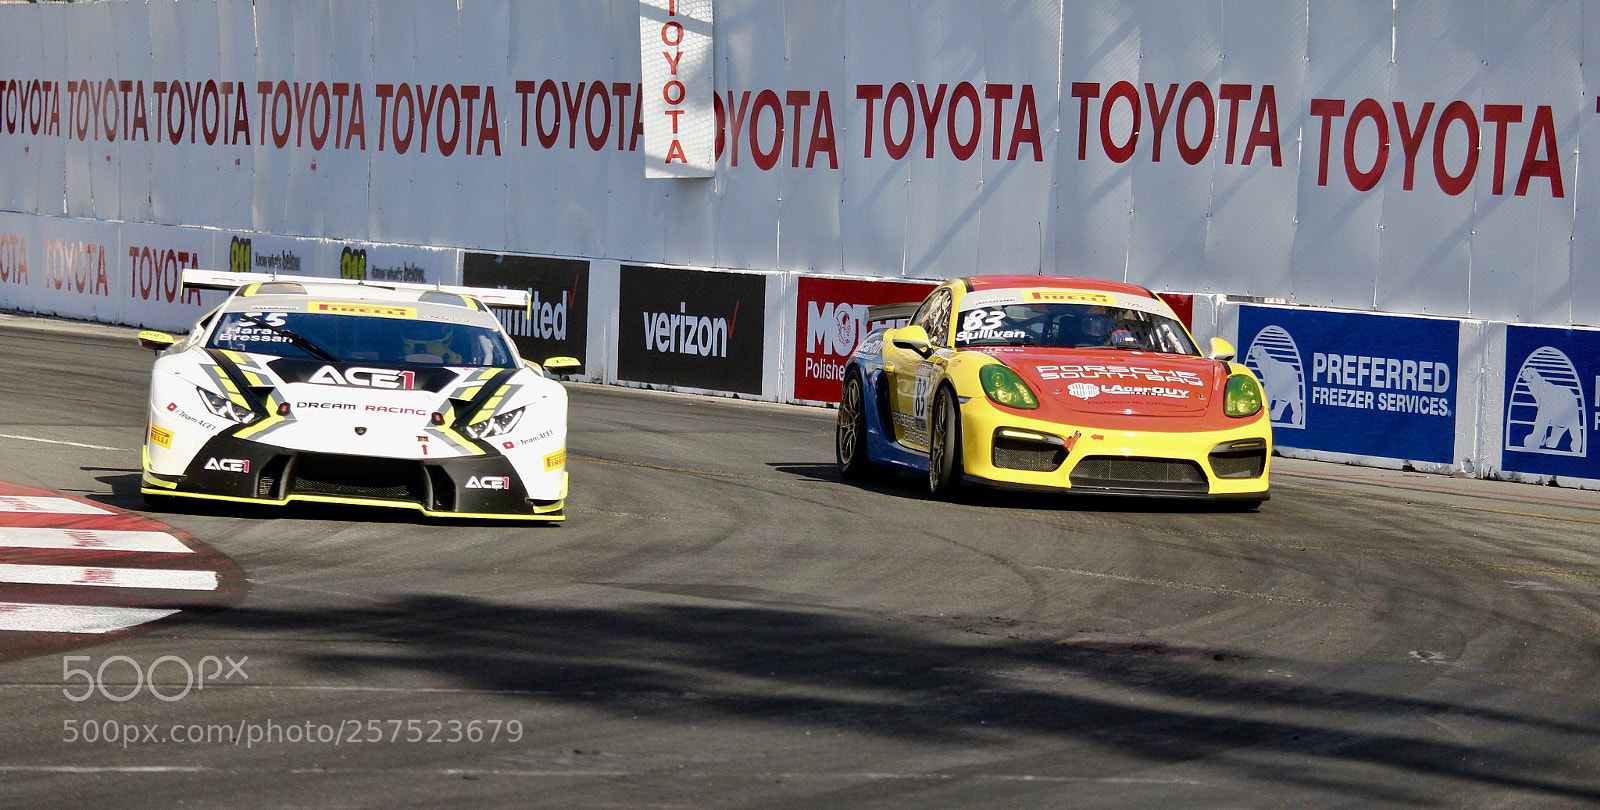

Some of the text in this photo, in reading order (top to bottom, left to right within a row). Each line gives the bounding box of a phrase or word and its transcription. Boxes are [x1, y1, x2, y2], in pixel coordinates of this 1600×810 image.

[67, 78, 149, 142] TOYOTA
[153, 79, 251, 145] TOYOTA
[257, 80, 366, 150] TOYOTA
[376, 82, 501, 156] TOYOTA
[856, 81, 1044, 162] TOYOTA
[1071, 80, 1282, 168] TOYOTA
[1310, 98, 1565, 198] TOYOTA
[43, 238, 109, 296] TOYOTA
[643, 301, 727, 358] verizon
[956, 329, 1026, 342] Sullivan
[963, 309, 1006, 332] 83
[220, 333, 293, 343] Bressan
[308, 364, 416, 390] ACE1
[1036, 365, 1198, 378] PORSCHE
[1040, 371, 1204, 386] SOUTH BAY
[1312, 351, 1450, 393] PREFERRED
[296, 402, 426, 416] DREAM RACING
[1312, 386, 1374, 410] FREEZER
[204, 457, 250, 474] ACE1
[464, 475, 510, 490] ACE1
